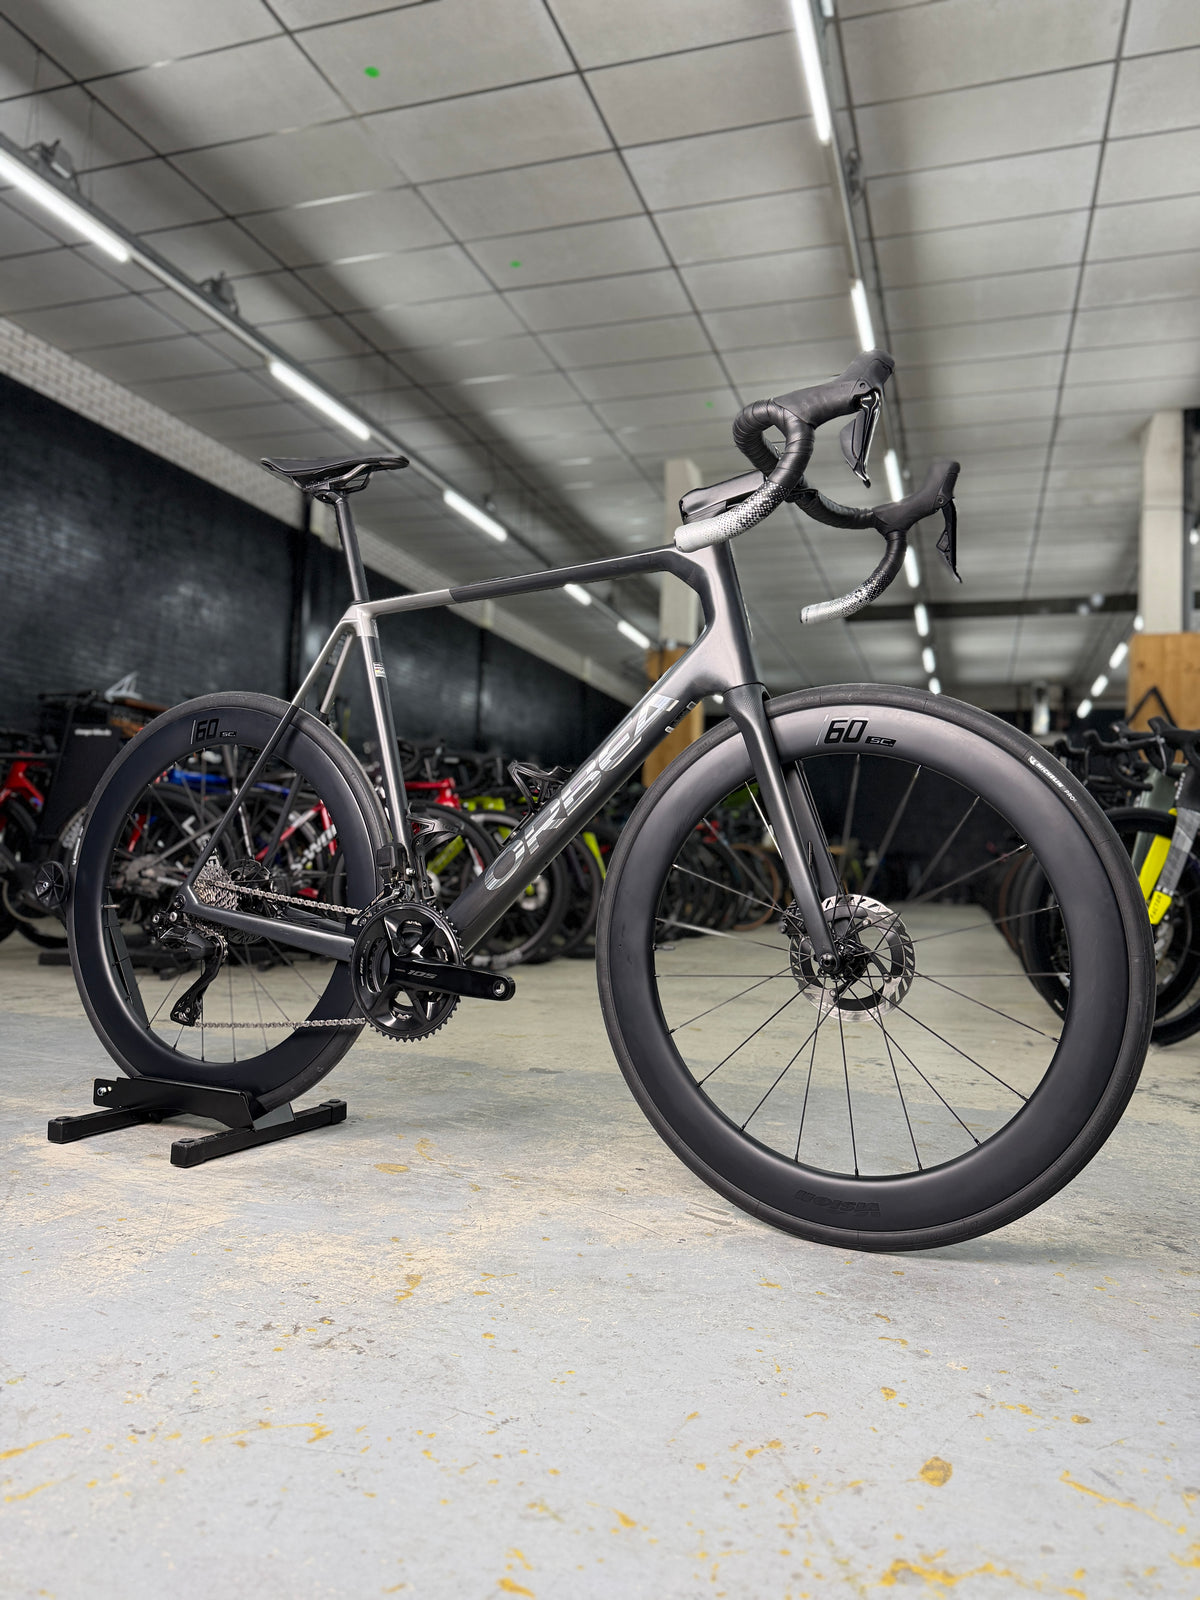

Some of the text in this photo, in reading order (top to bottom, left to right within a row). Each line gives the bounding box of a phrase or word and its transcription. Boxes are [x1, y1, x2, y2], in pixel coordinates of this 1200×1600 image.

[196, 719, 219, 742] 60
[824, 718, 868, 743] 60
[1036, 763, 1064, 788] MICHELIN
[484, 693, 680, 891] ORBEA
